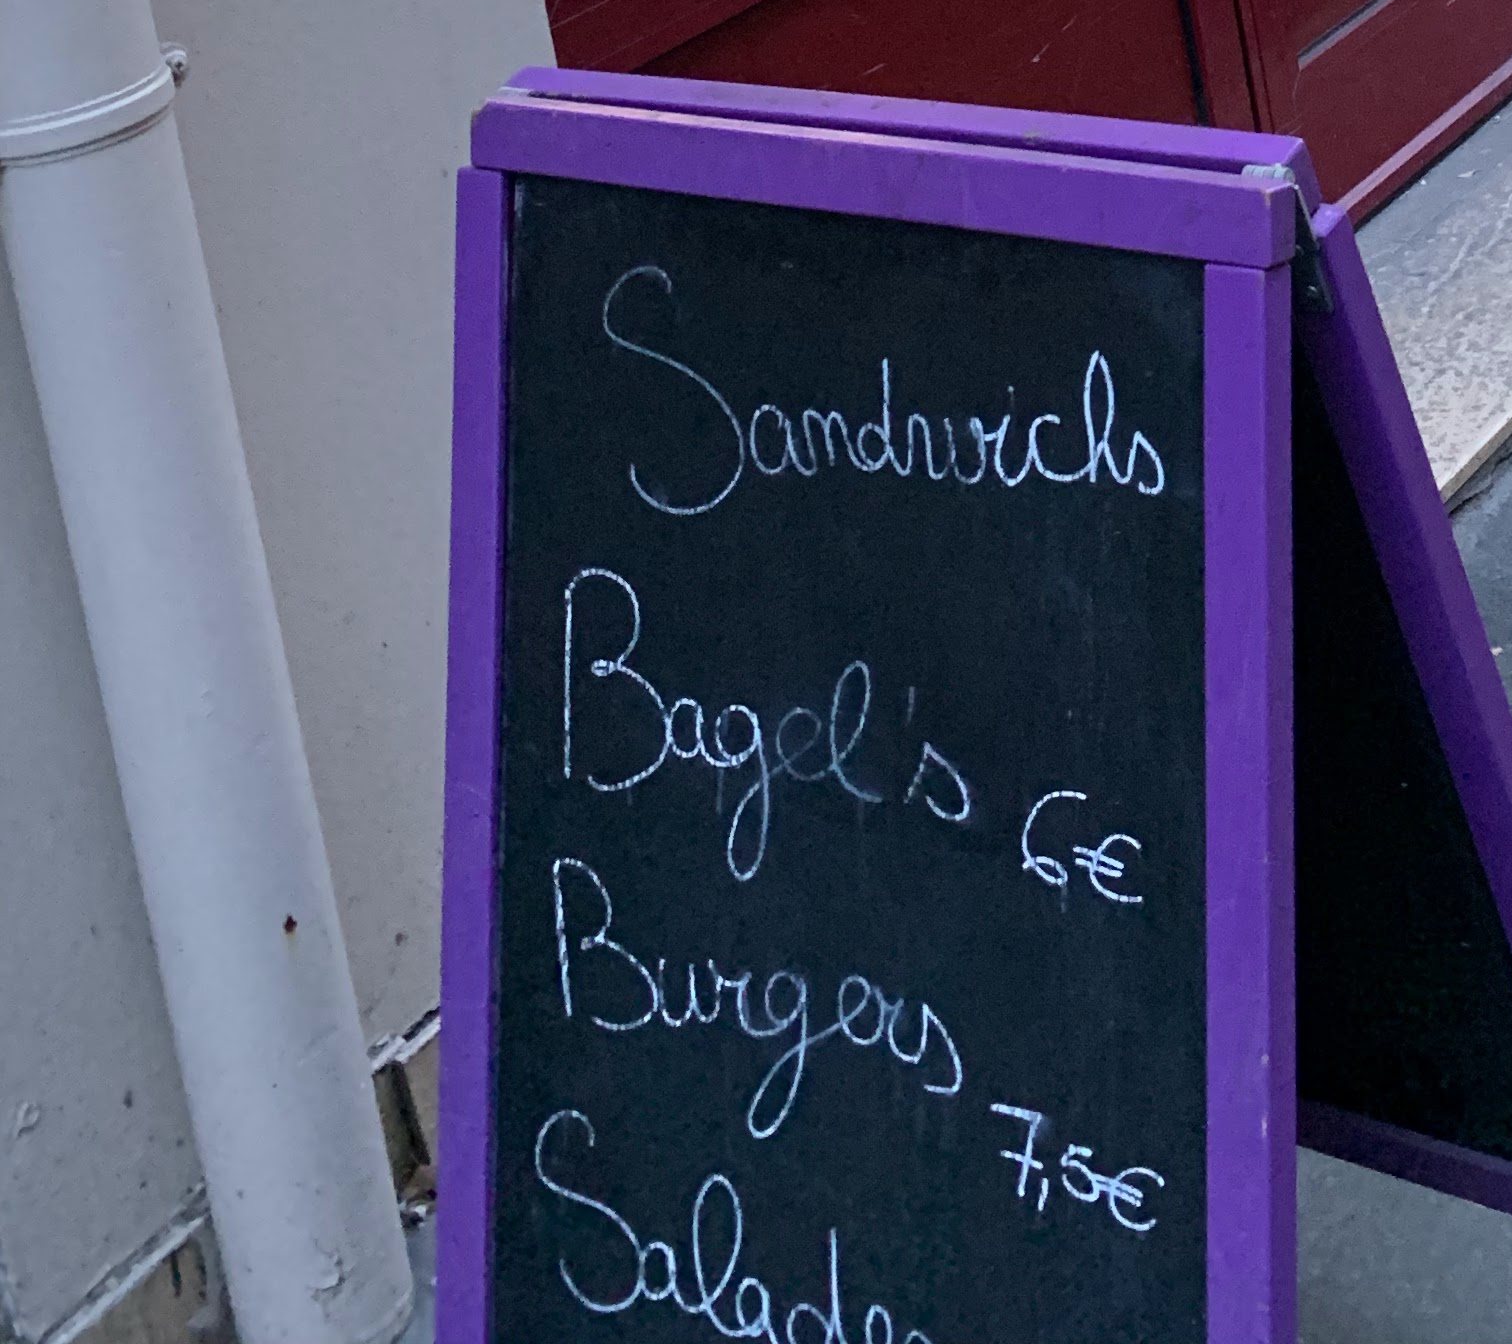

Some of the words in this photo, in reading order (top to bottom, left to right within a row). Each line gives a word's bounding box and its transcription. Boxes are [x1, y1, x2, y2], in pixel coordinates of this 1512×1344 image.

[602, 265, 1165, 515] Sandwichs
[1022, 790, 1143, 904] 6€
[553, 857, 963, 1140] Burgers
